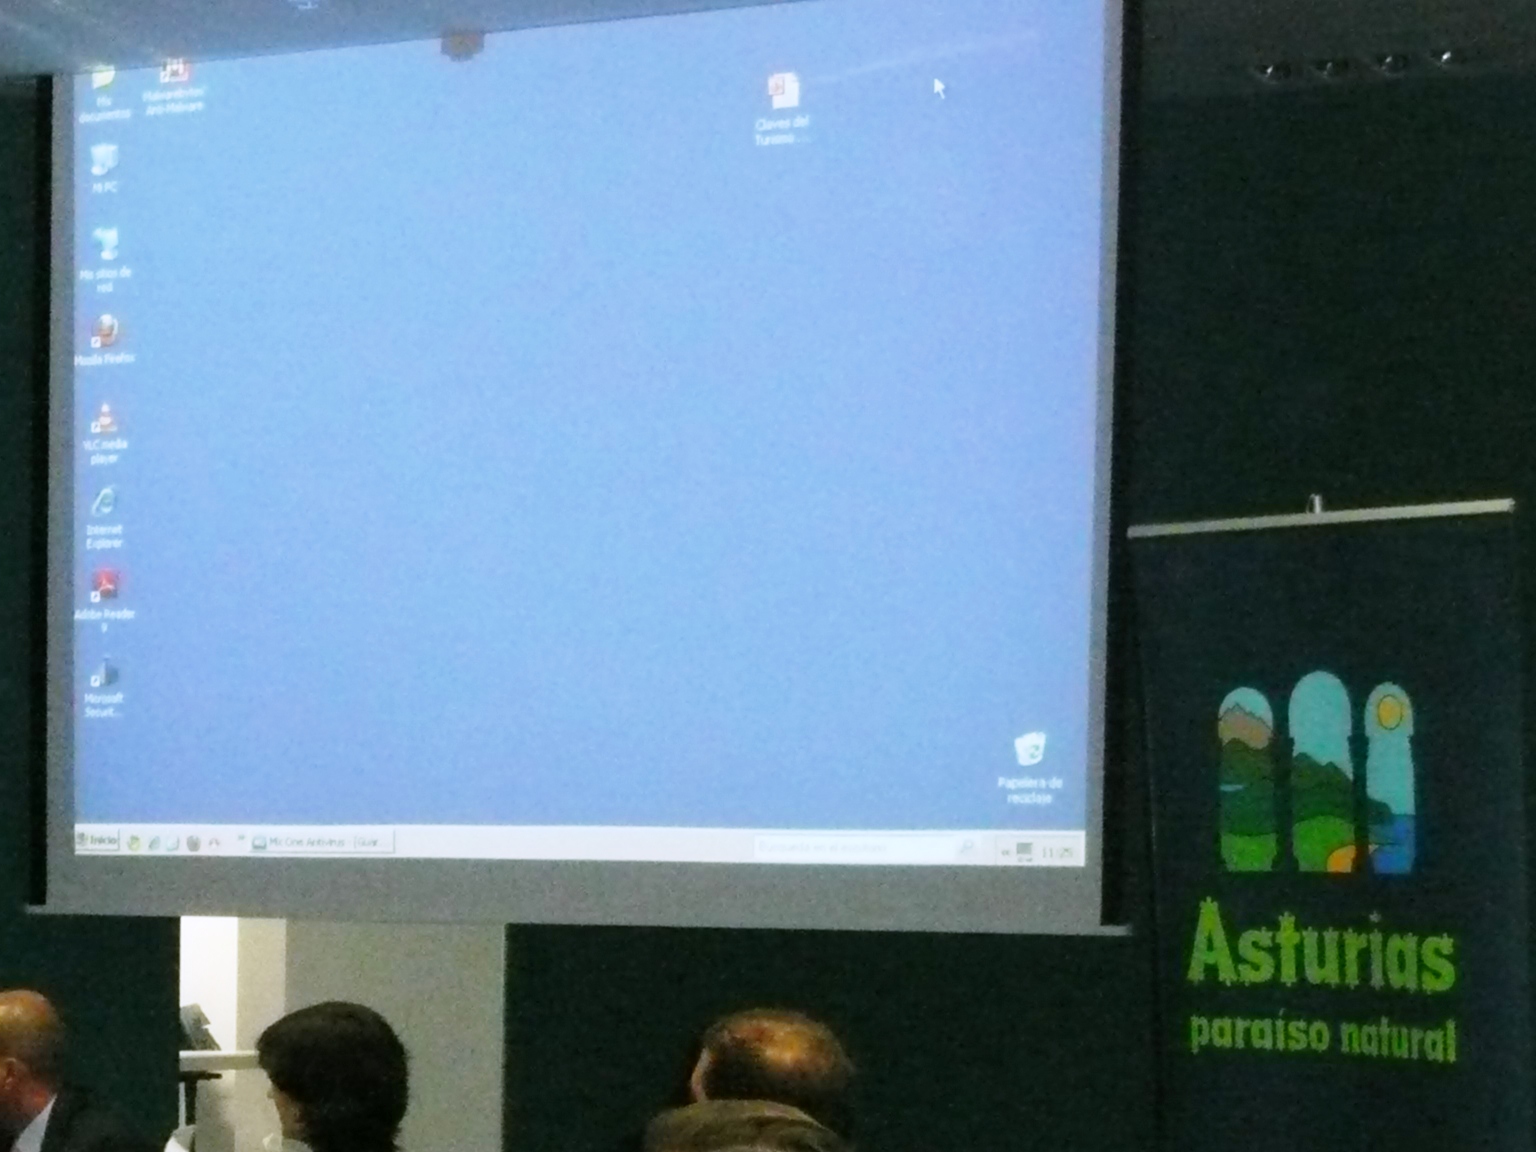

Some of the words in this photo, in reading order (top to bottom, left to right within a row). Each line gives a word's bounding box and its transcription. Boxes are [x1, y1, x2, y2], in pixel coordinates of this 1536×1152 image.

[1186, 896, 1457, 994] Asturias
[1190, 1007, 1331, 1054] paraíso
[1340, 1016, 1457, 1063] natural
